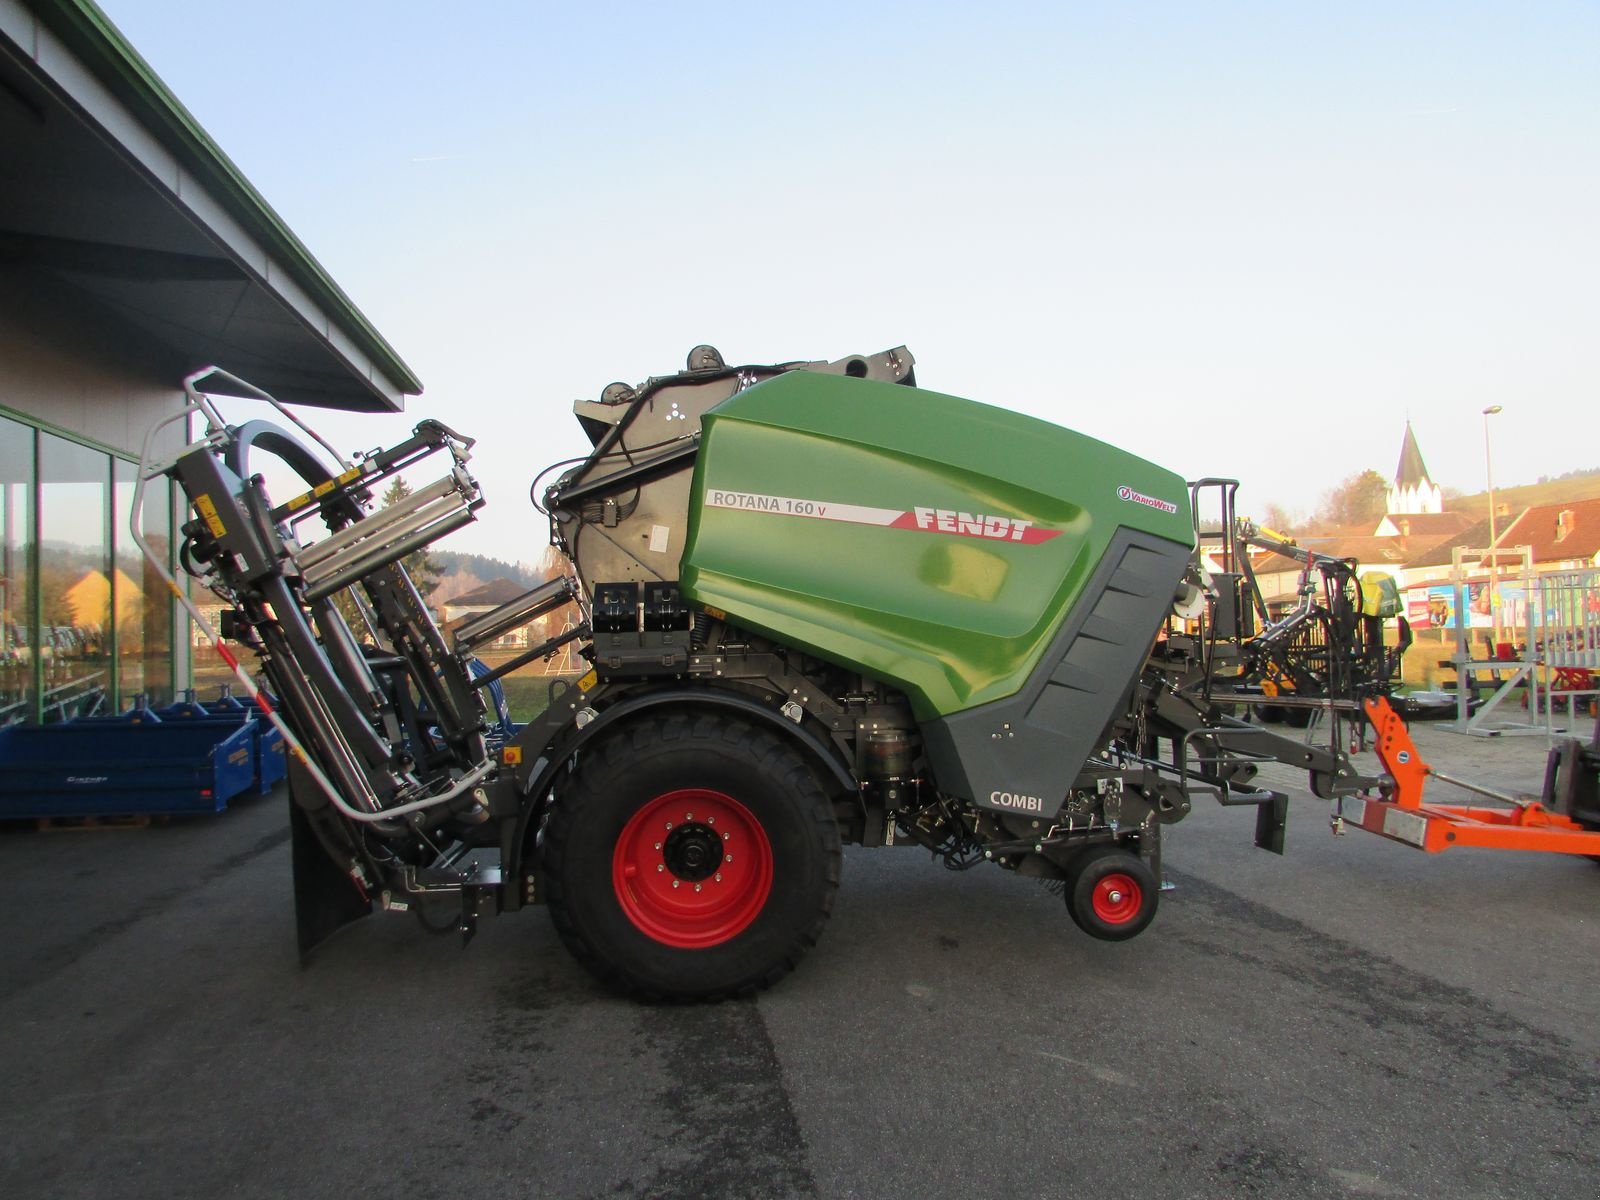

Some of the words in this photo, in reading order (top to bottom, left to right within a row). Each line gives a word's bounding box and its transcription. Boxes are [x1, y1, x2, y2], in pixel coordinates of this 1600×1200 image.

[713, 492, 780, 512] ROTANA
[786, 500, 814, 515] 160
[914, 506, 1033, 541] FENDT
[990, 791, 1042, 812] COMBI
